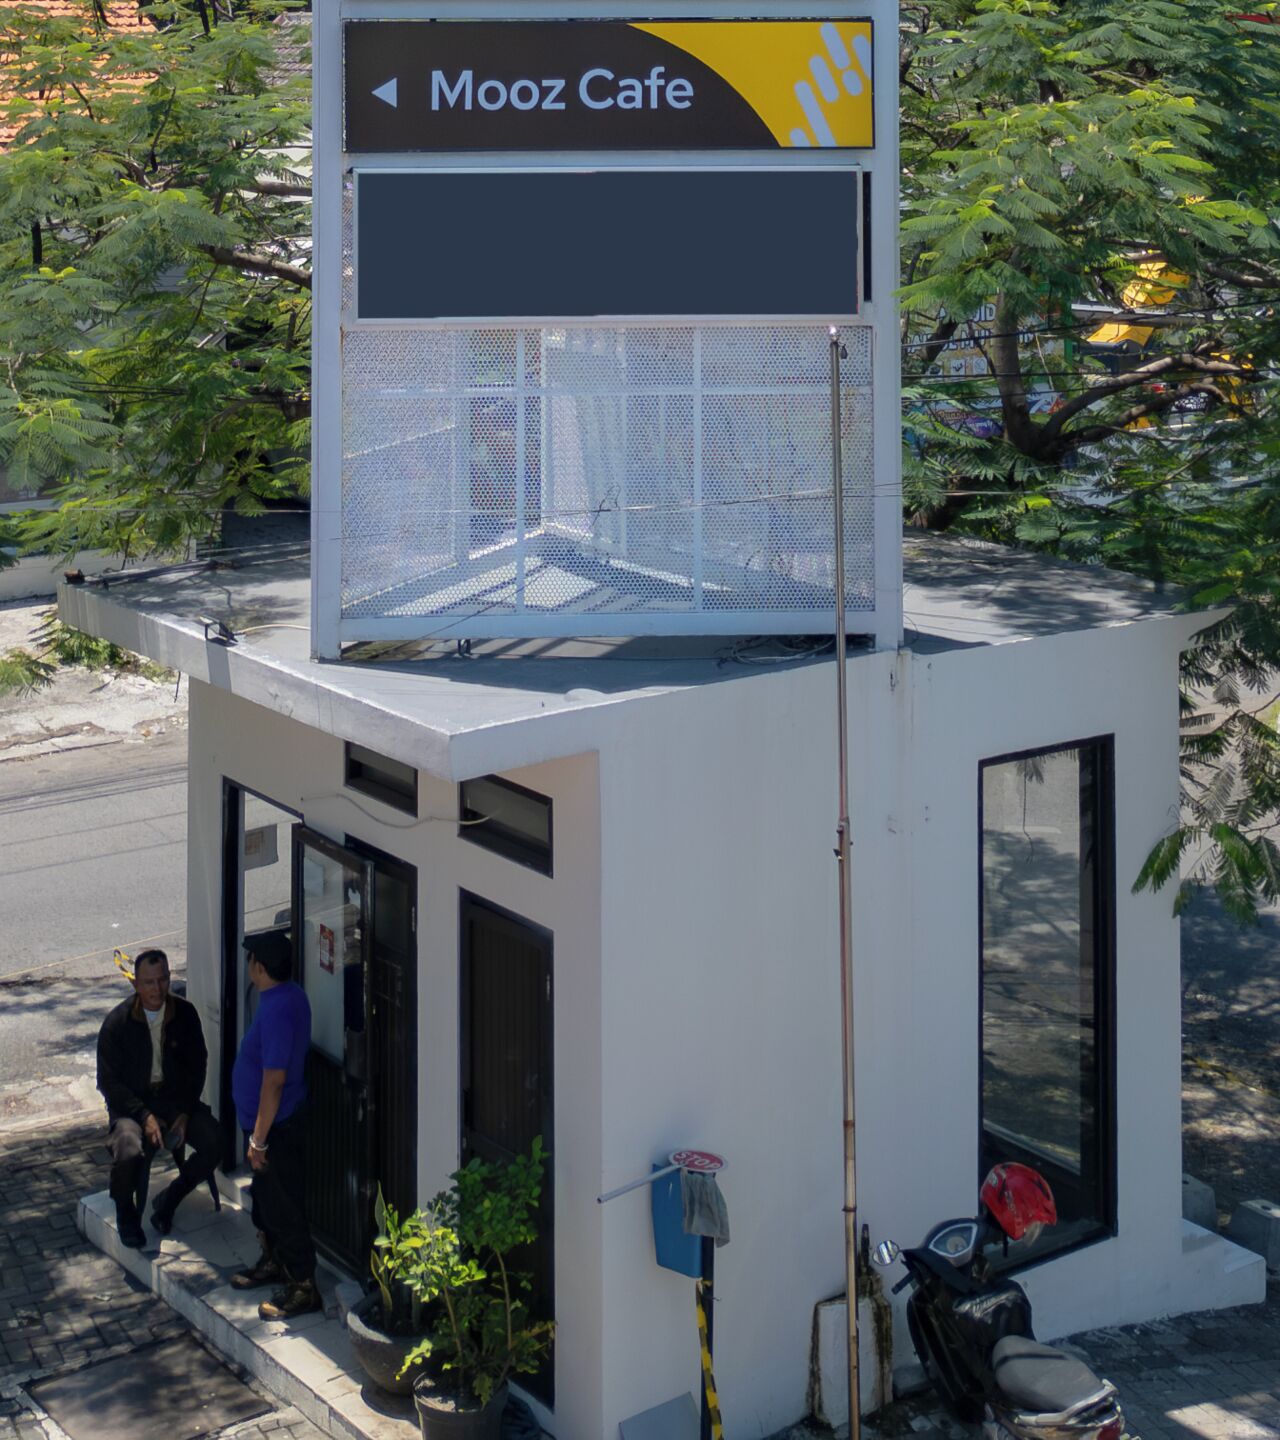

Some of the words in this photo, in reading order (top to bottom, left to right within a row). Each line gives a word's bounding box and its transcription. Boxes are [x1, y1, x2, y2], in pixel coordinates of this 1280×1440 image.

[431, 69, 566, 111] Mooz
[578, 66, 694, 110] Cafe
[674, 1150, 721, 1169] STOP
